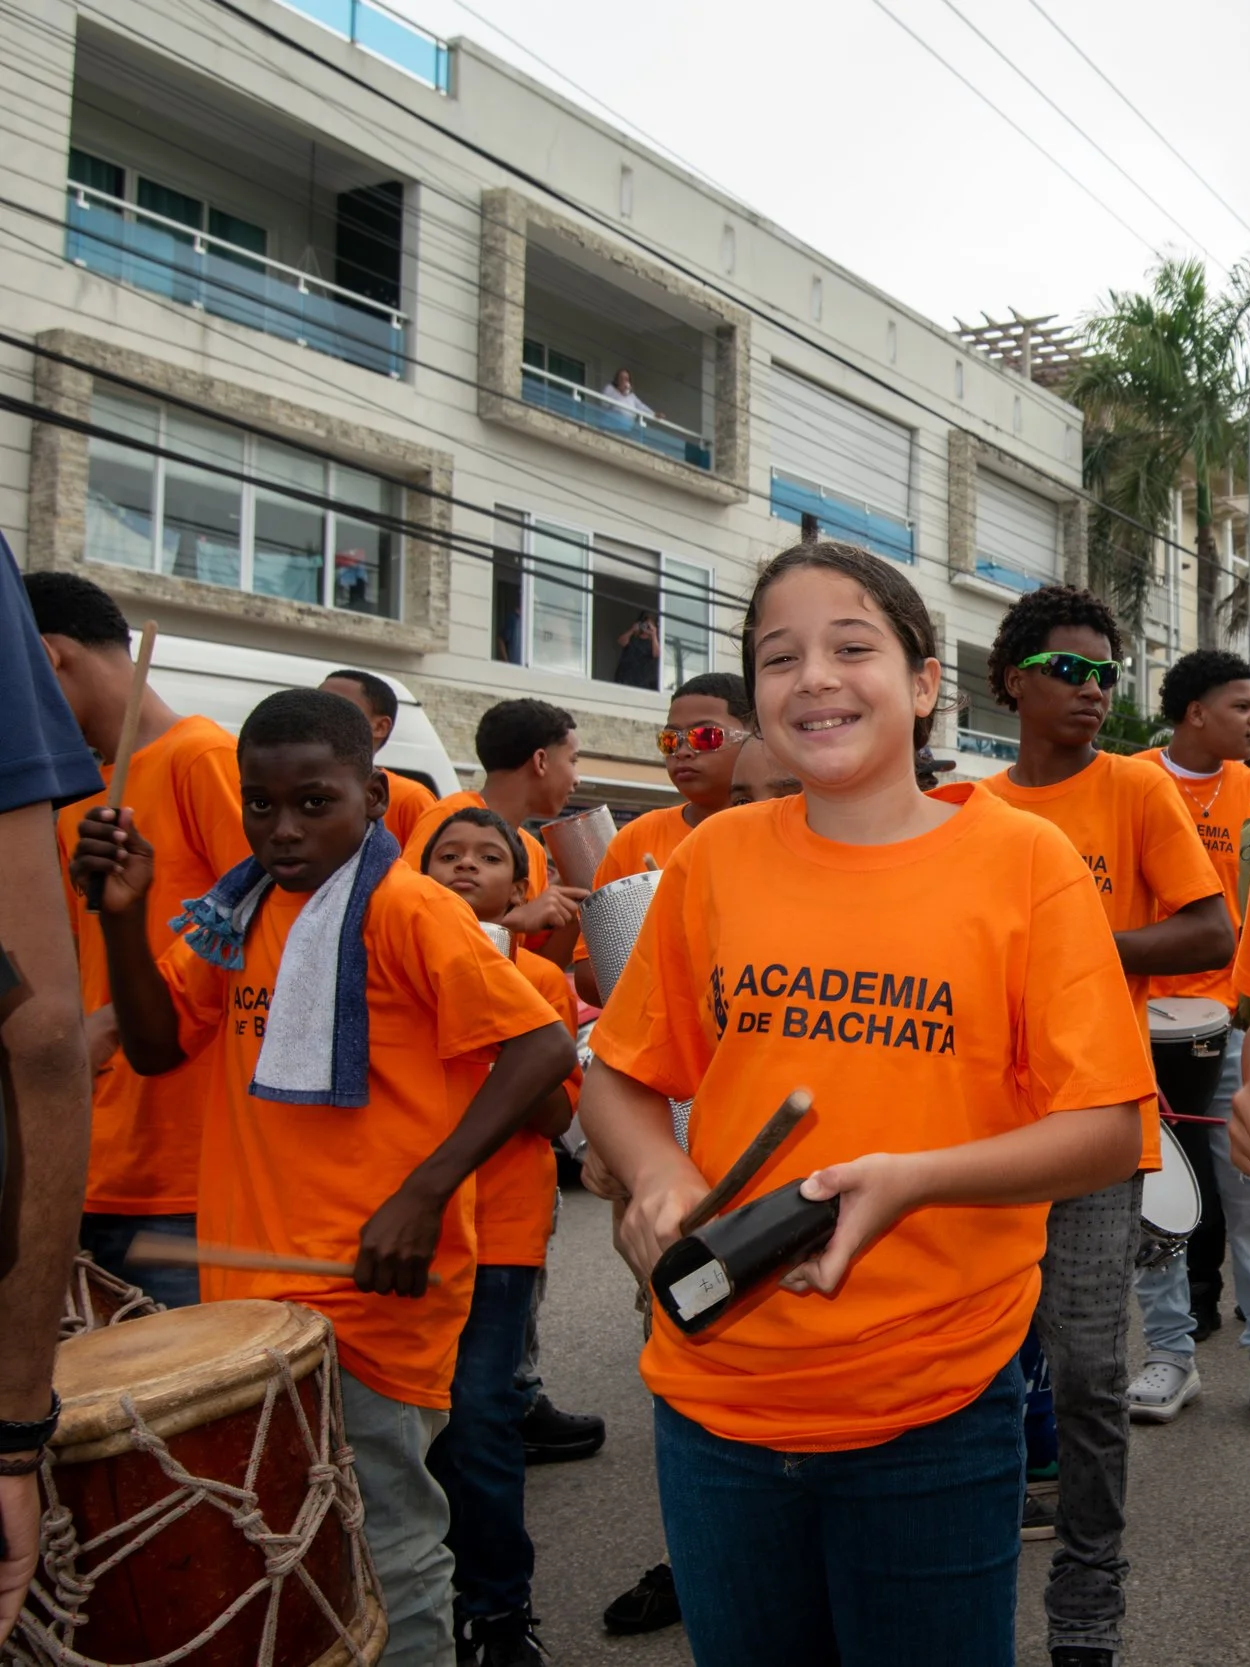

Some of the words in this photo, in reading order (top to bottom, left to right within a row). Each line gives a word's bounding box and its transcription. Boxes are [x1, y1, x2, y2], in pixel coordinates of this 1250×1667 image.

[234, 986, 276, 1011] ACA
[734, 964, 953, 1016] ACADEMIA
[738, 1012, 772, 1033] DE
[782, 1006, 956, 1056] BACHATA
